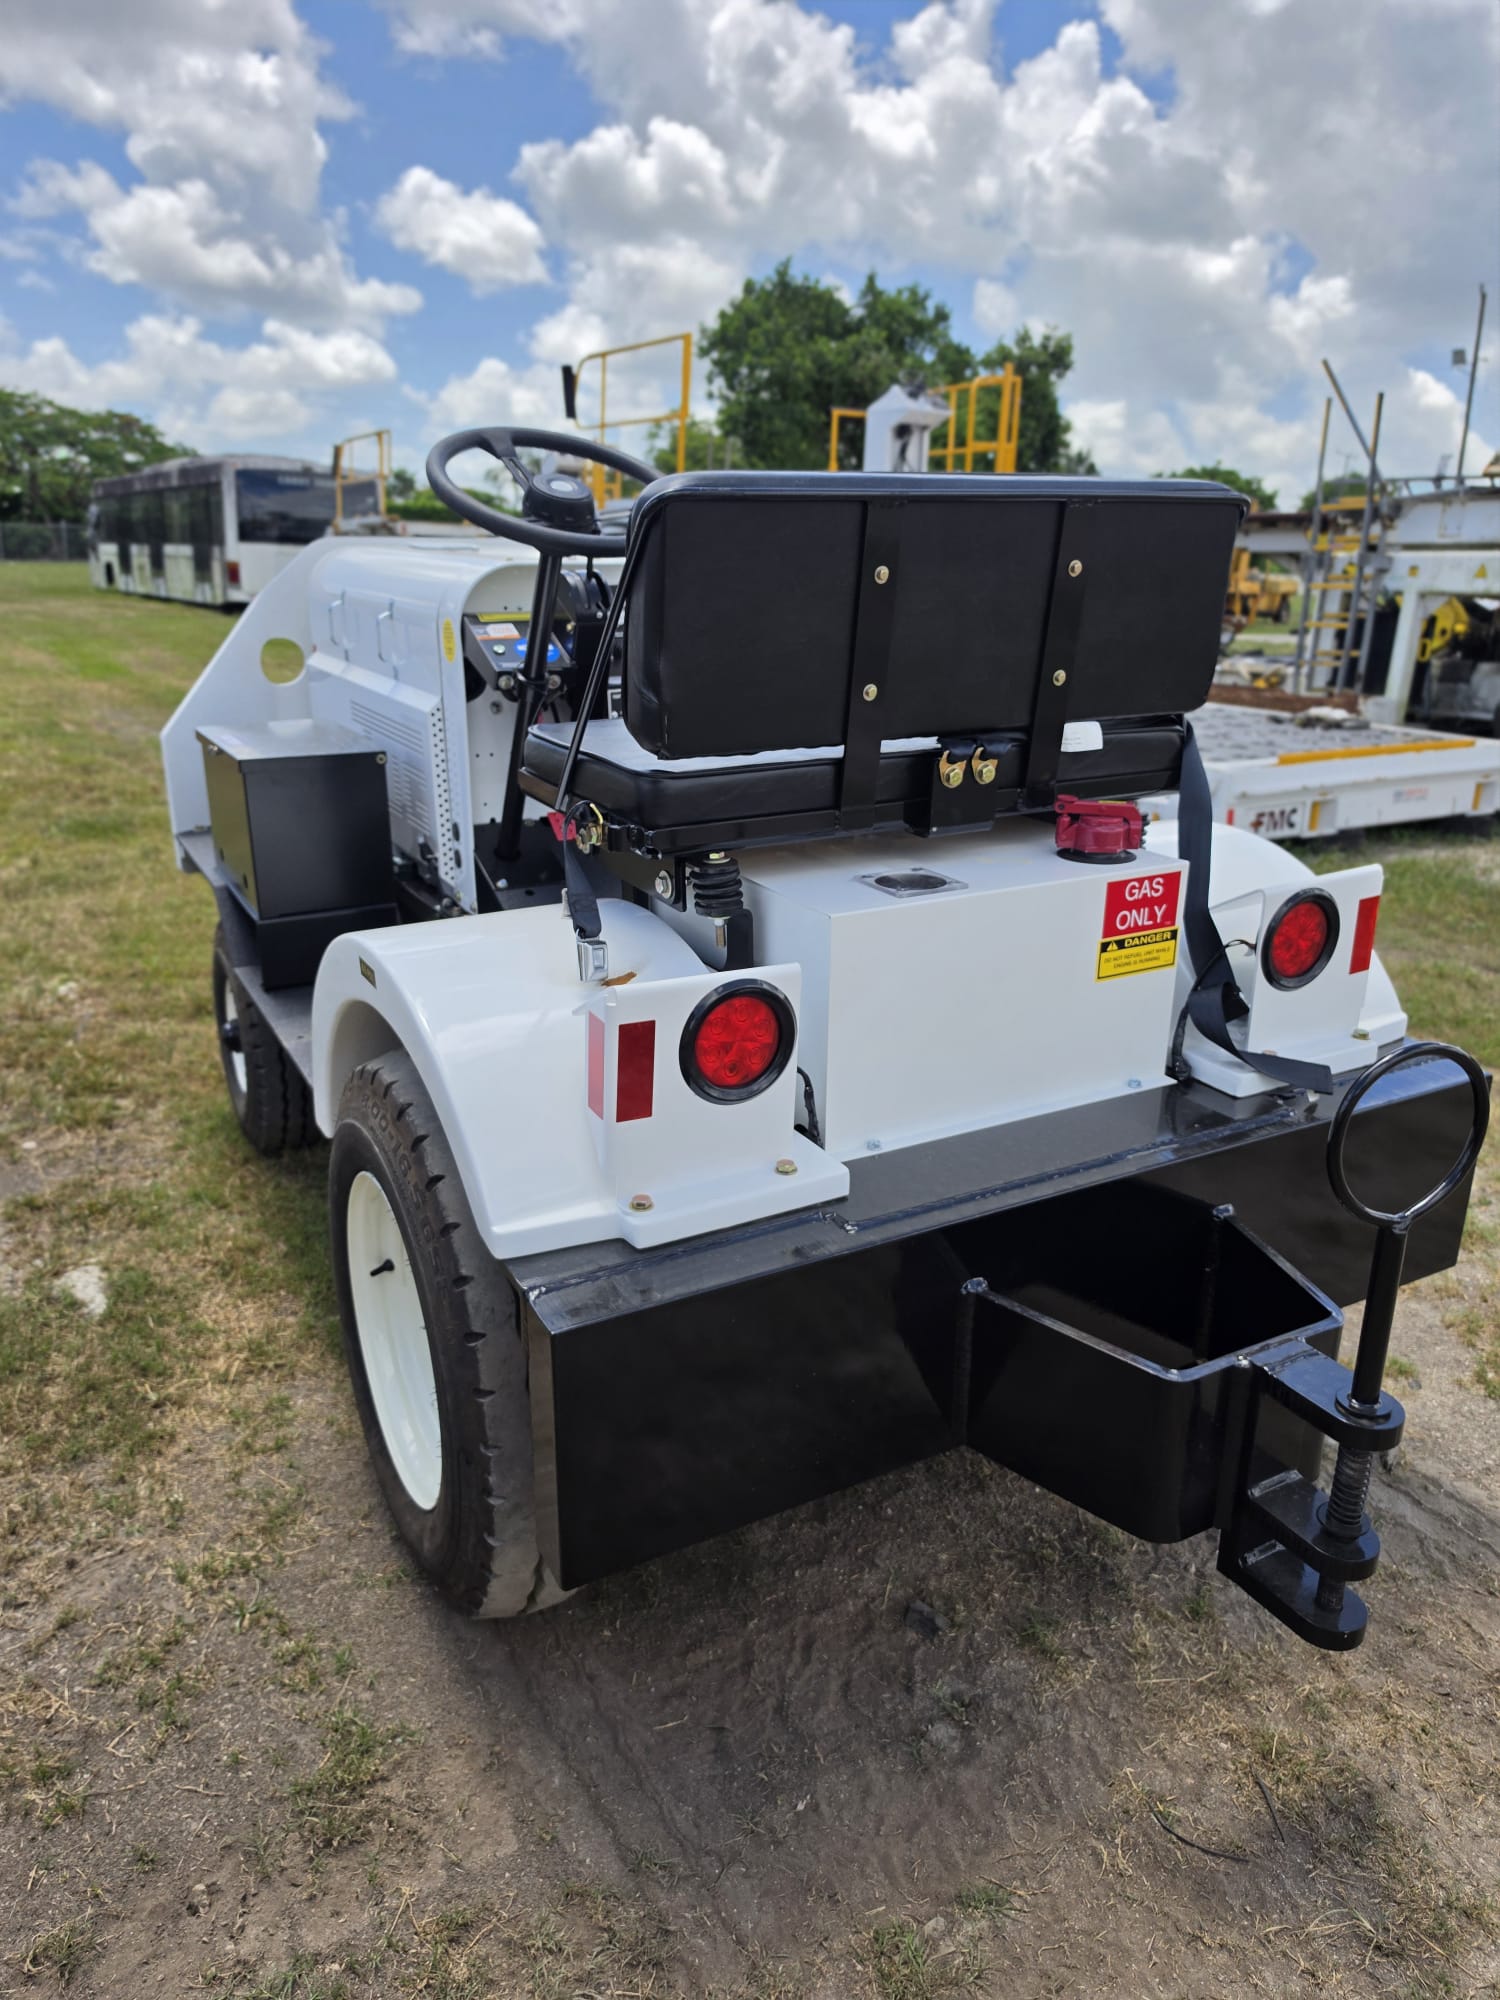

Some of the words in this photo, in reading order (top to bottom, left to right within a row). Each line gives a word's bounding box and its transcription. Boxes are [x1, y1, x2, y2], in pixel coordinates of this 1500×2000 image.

[1253, 807, 1298, 833] FMC
[1125, 877, 1164, 901] GAS
[1115, 904, 1168, 930] ONLY
[1124, 931, 1171, 947] DANGER
